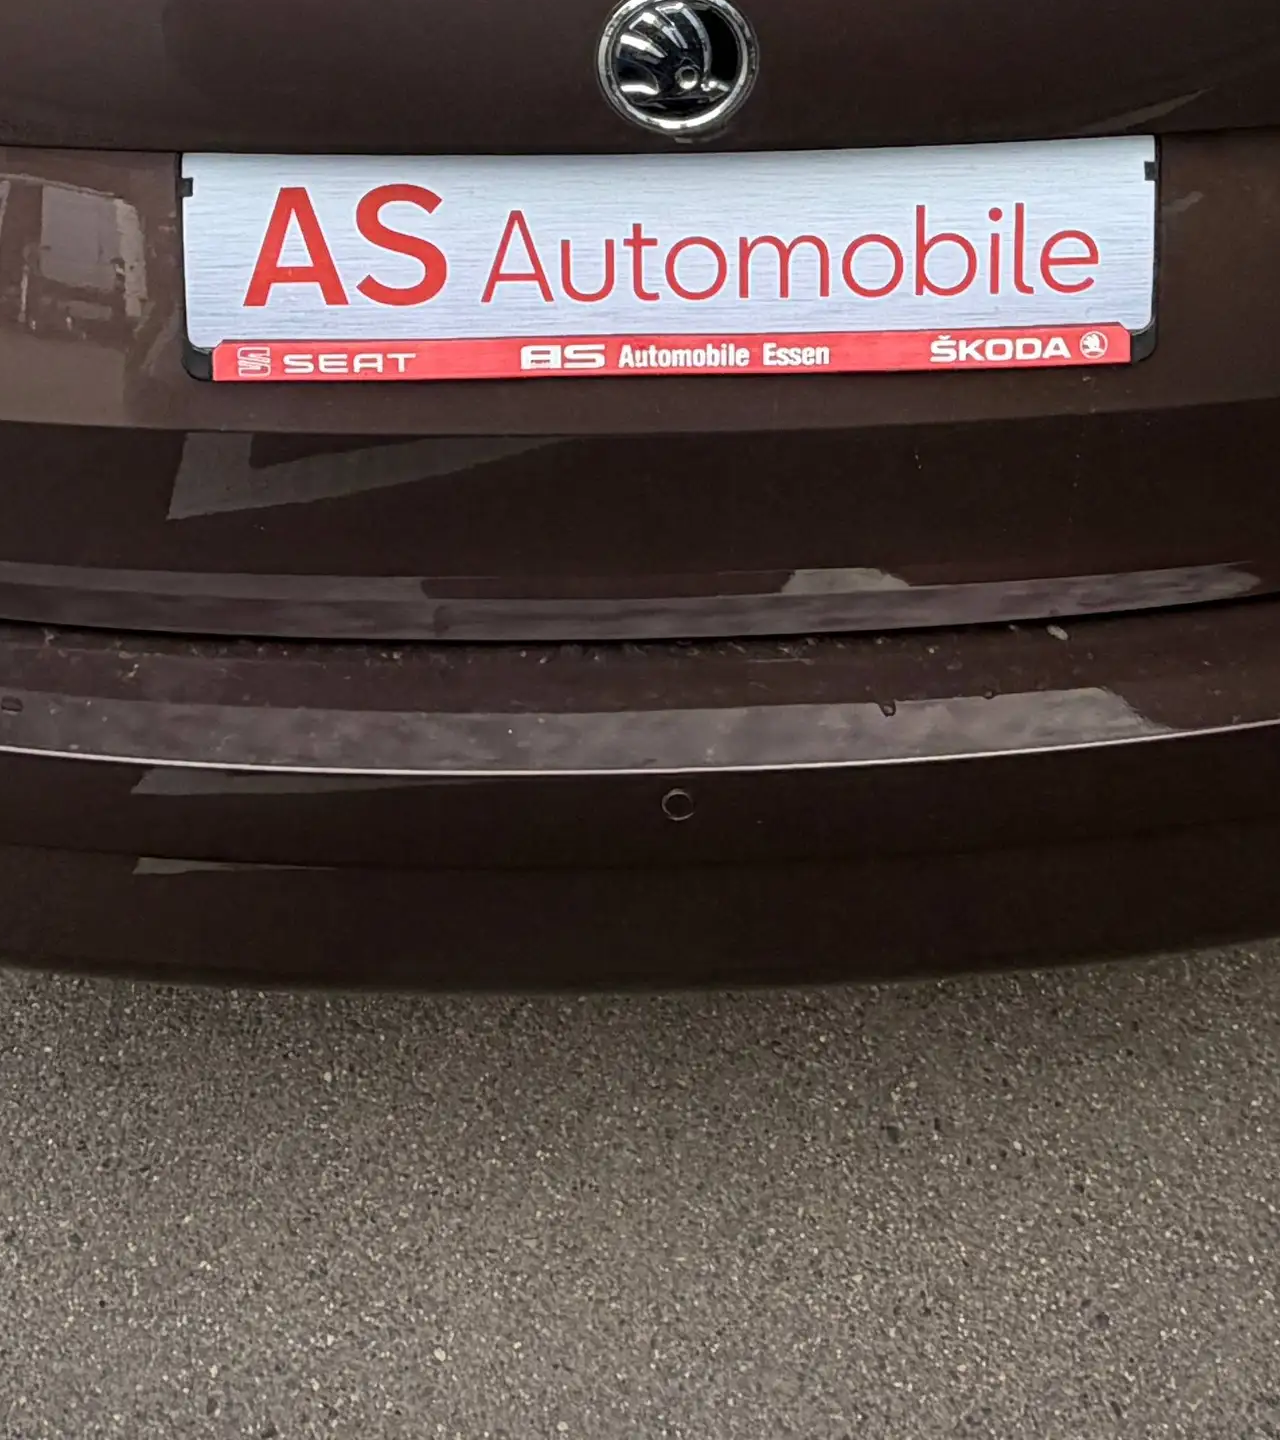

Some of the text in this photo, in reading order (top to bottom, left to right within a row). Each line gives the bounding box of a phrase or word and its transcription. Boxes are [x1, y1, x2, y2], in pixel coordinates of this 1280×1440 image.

[244, 183, 1101, 308] AS Automobile
[520, 342, 830, 370] AS Automobile Essen
[929, 334, 1072, 363] ŠKODA
[283, 352, 417, 374] SEAT
